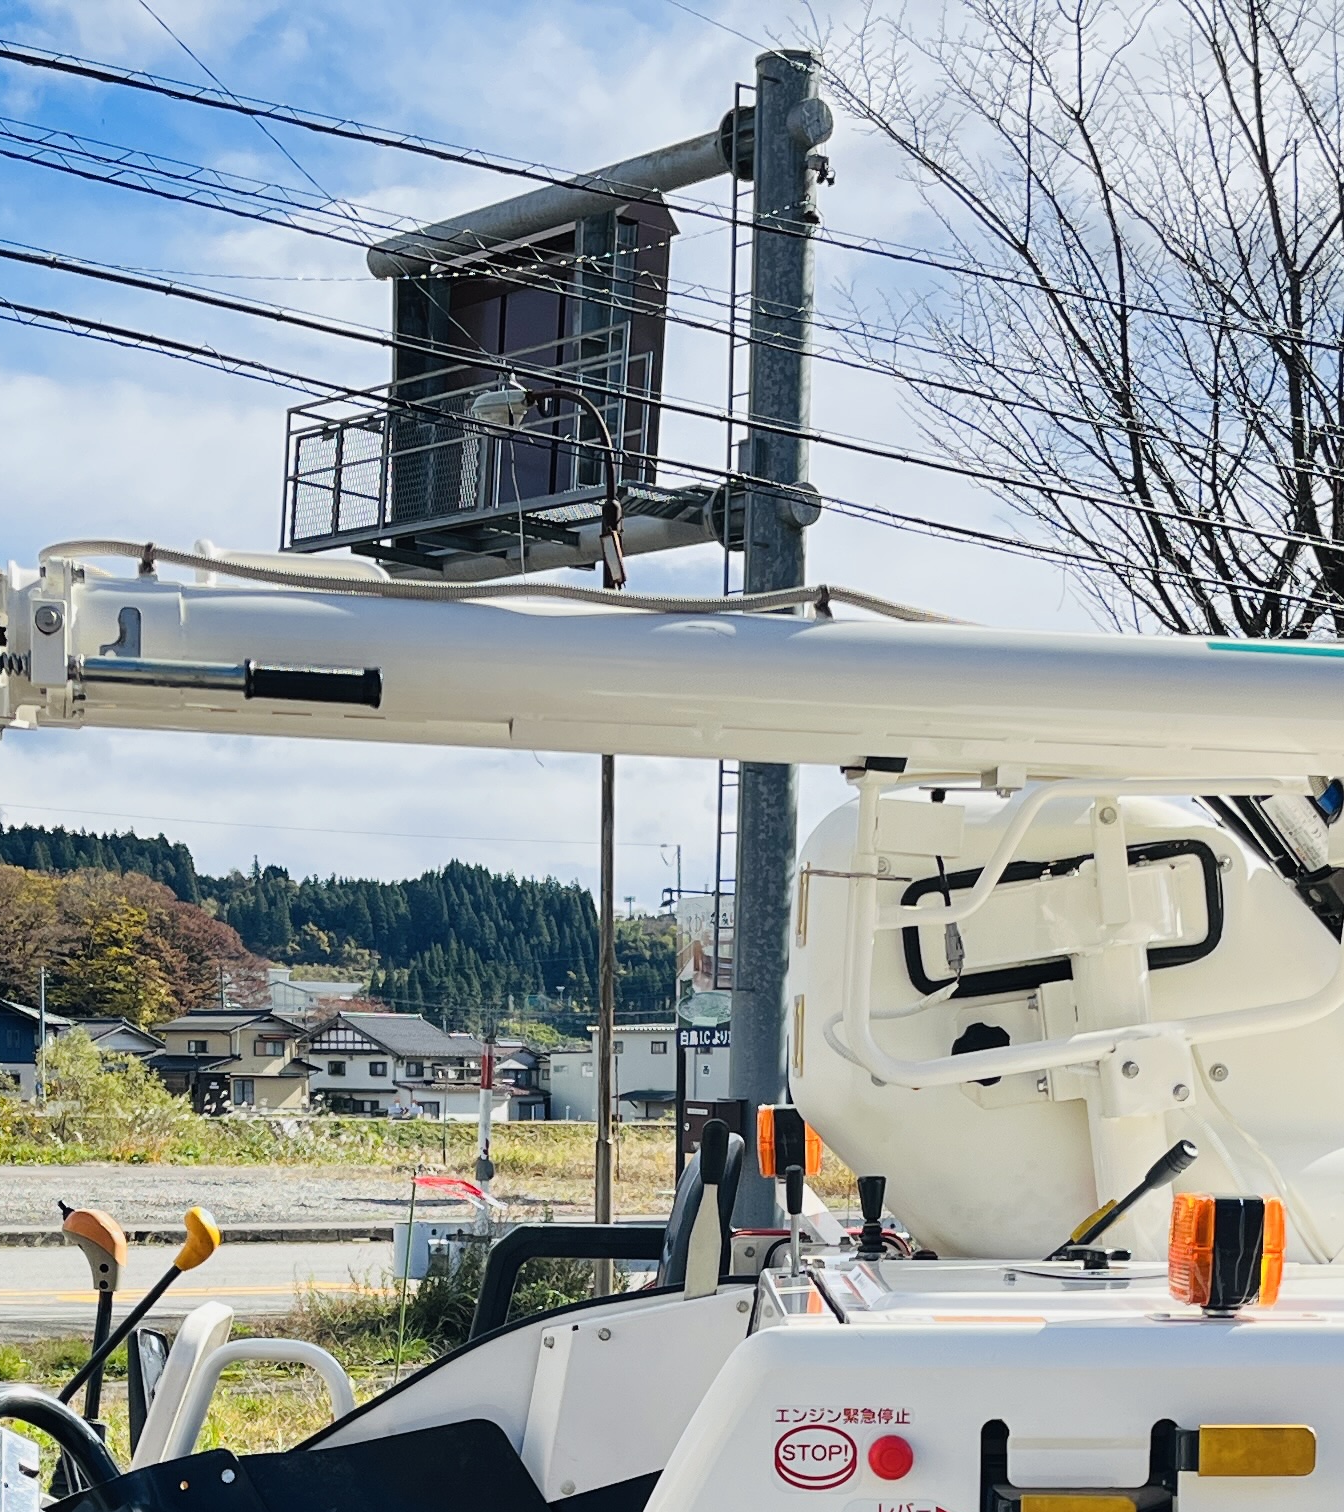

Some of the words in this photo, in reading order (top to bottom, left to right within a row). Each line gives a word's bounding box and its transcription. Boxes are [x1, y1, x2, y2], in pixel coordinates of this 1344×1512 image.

[775, 1407, 911, 1425] エンジン緊急停止
[782, 1444, 849, 1462] STOP!
